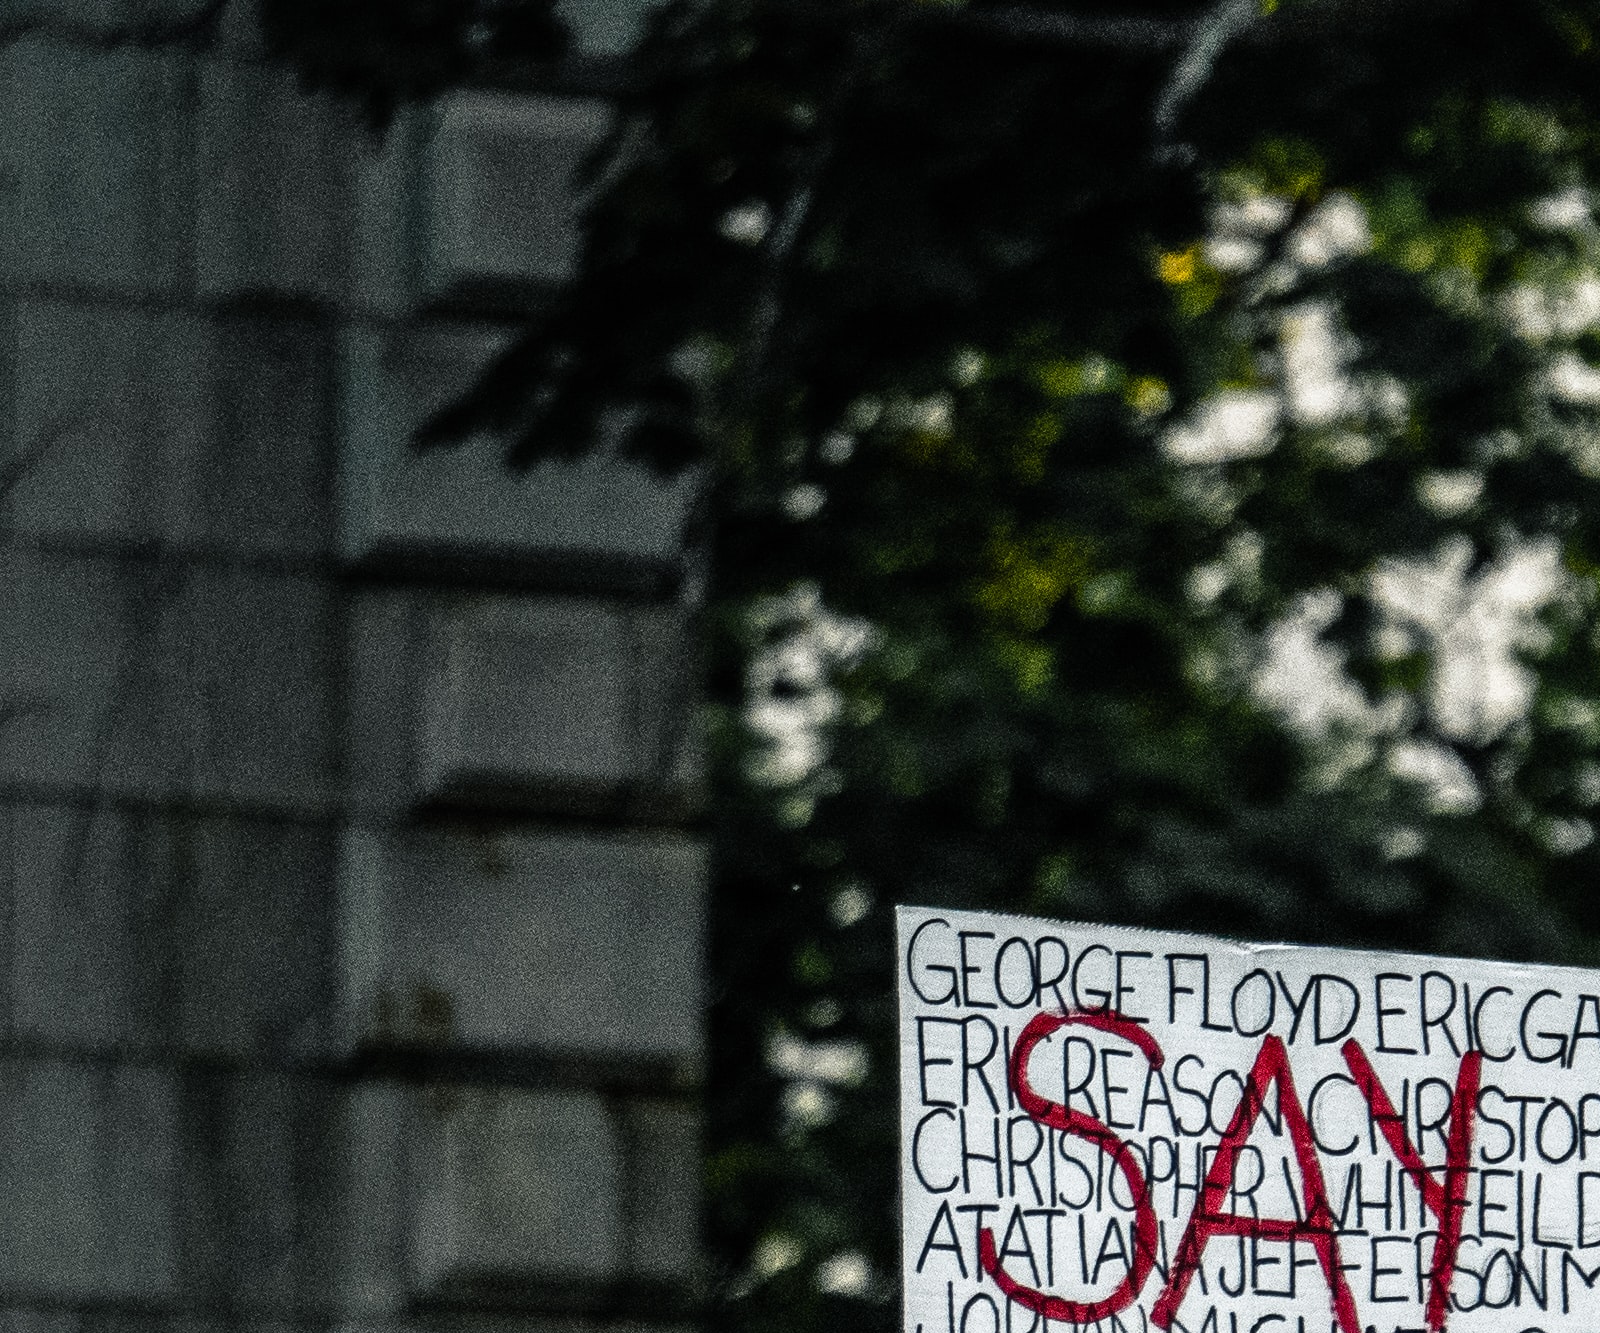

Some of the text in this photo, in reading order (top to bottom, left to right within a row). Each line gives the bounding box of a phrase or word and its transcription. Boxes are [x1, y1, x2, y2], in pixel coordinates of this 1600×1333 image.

[908, 918, 1153, 1024] GEORGE
[1164, 953, 1361, 1045] FLOYD
[1376, 971, 1517, 1061] ERIC
[1063, 1036, 1282, 1137] REASON
[912, 1109, 1265, 1222] CHRISTOPHER
[917, 1200, 1208, 1298] ATATIANA
[1218, 1230, 1548, 1313] JEFFERSON
